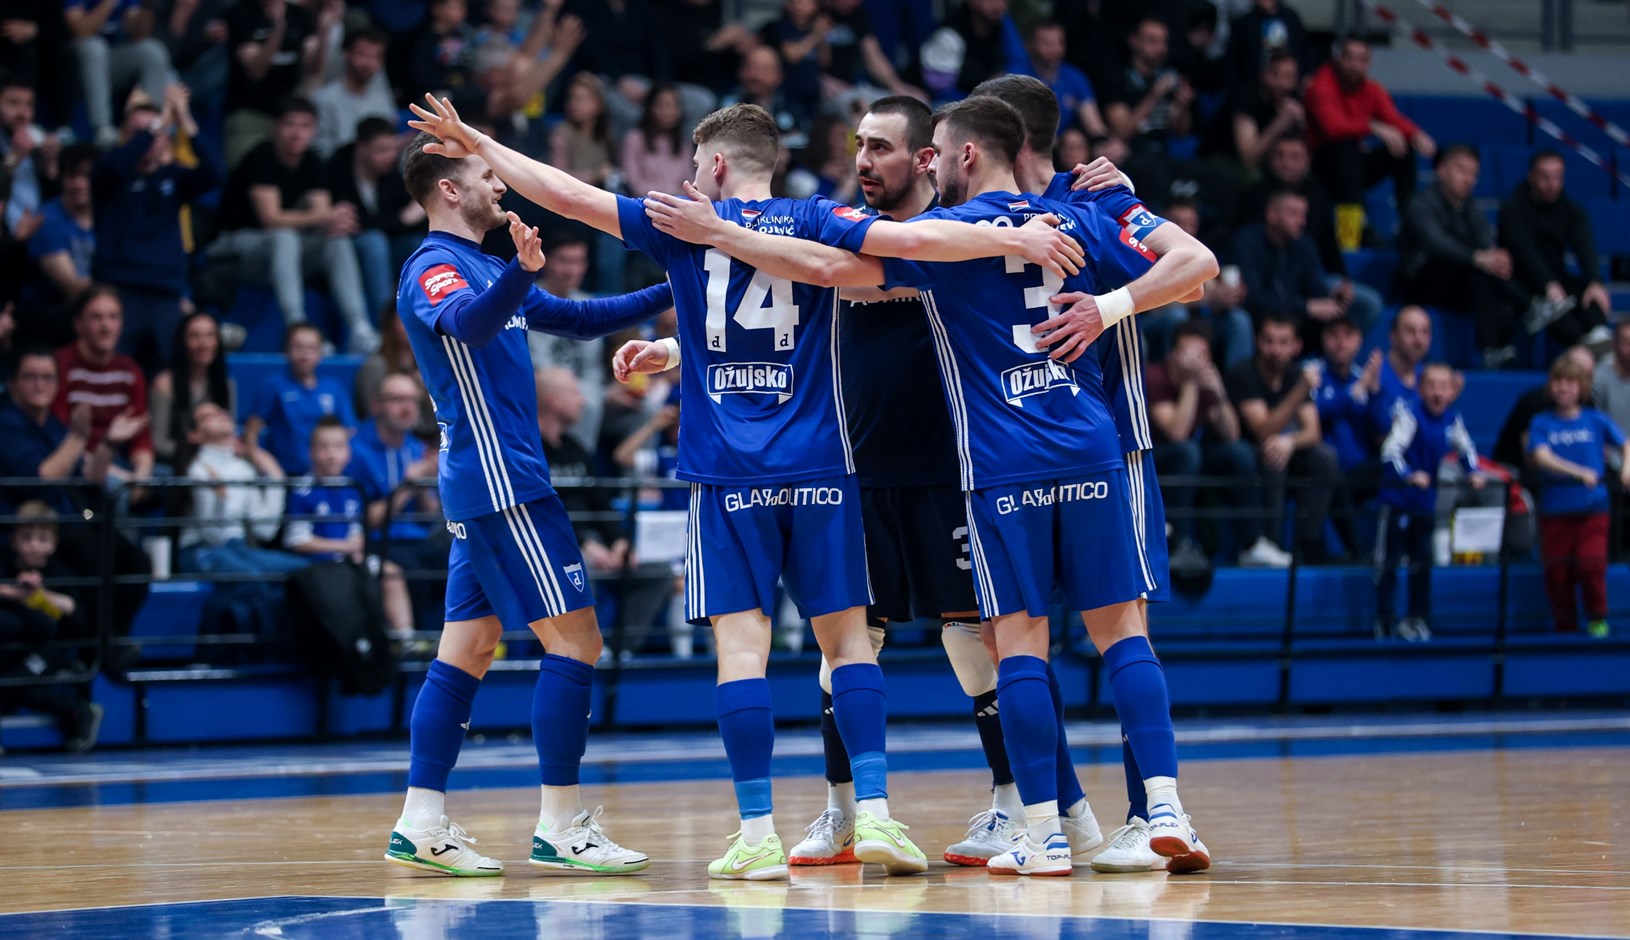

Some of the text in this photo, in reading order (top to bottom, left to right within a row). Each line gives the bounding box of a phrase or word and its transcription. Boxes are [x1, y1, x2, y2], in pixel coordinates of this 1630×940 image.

[746, 215, 795, 230] PIKLINIKA
[703, 248, 800, 353] 14
[714, 366, 788, 391] Ožujsko
